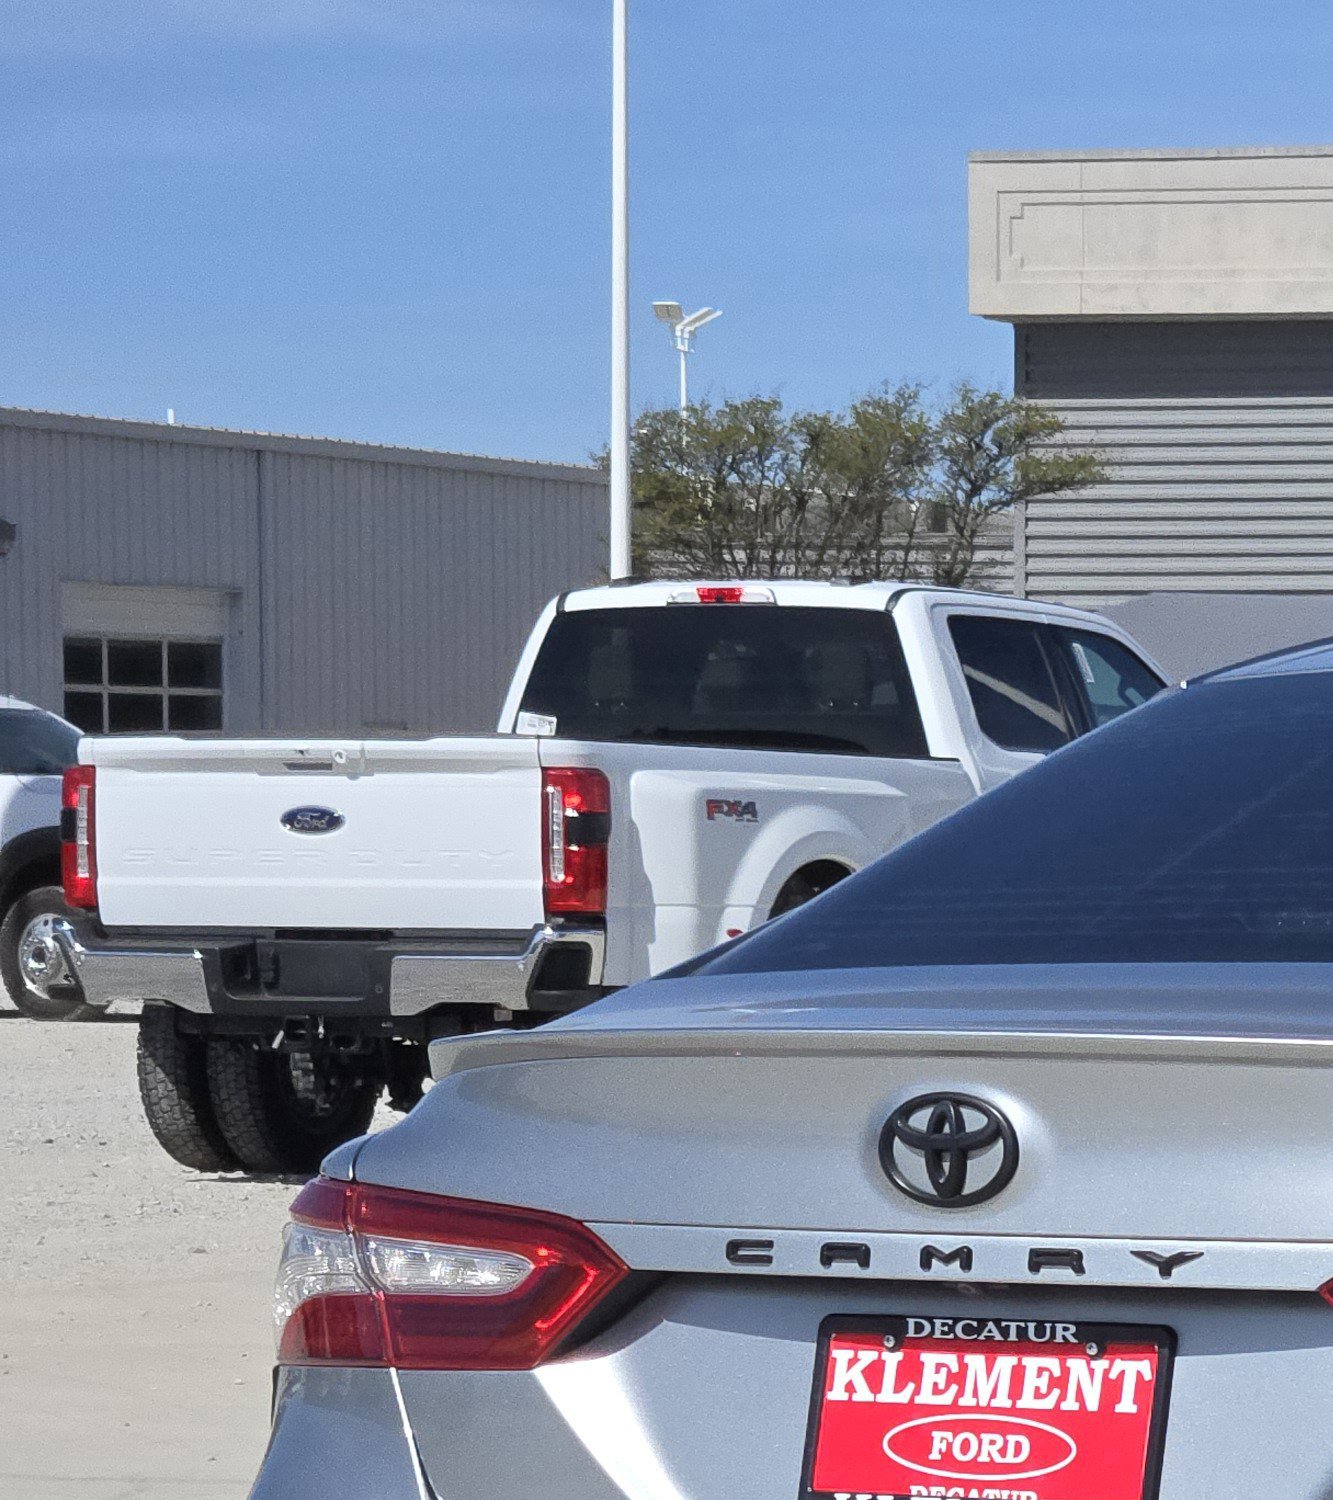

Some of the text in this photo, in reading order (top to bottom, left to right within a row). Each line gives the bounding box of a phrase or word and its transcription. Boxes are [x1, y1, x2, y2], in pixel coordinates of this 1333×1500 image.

[706, 799, 758, 821] FX4
[121, 846, 514, 867] SUPER DUTY
[726, 1238, 1205, 1280] CAMRY
[905, 1317, 1079, 1344] DECATUR
[826, 1348, 1153, 1414] KLEMENT
[928, 1430, 1031, 1464] FORD
